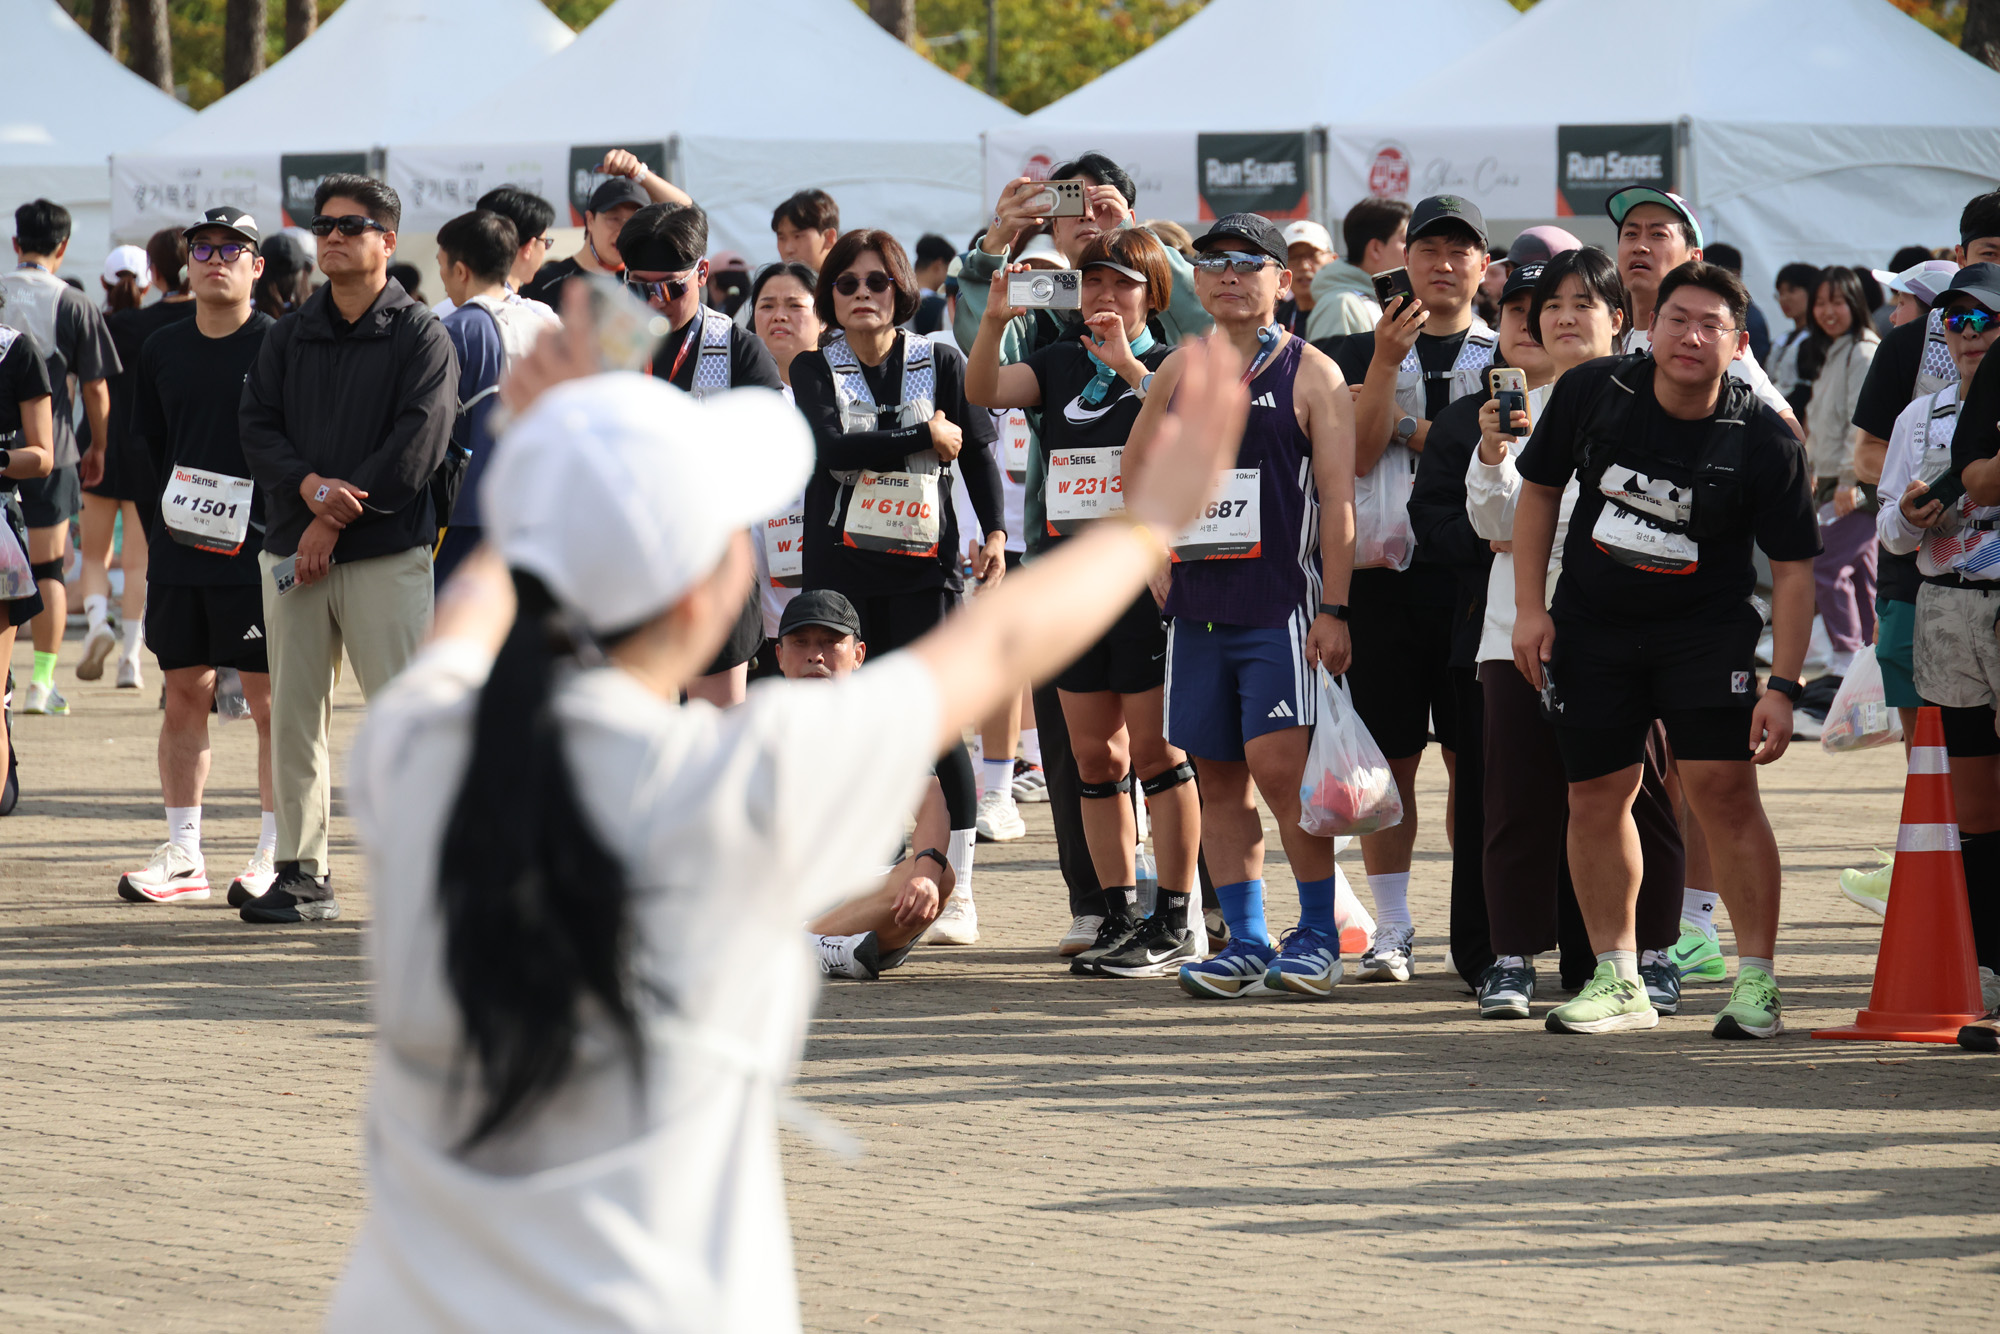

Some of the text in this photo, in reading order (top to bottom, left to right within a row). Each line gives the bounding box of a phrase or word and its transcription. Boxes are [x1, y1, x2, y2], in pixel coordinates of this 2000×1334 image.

[1058, 475, 1123, 495] W 2313
[173, 494, 238, 519] M 1501
[861, 499, 875, 510] W
[1195, 500, 1248, 519] 687
[777, 540, 792, 553] W
